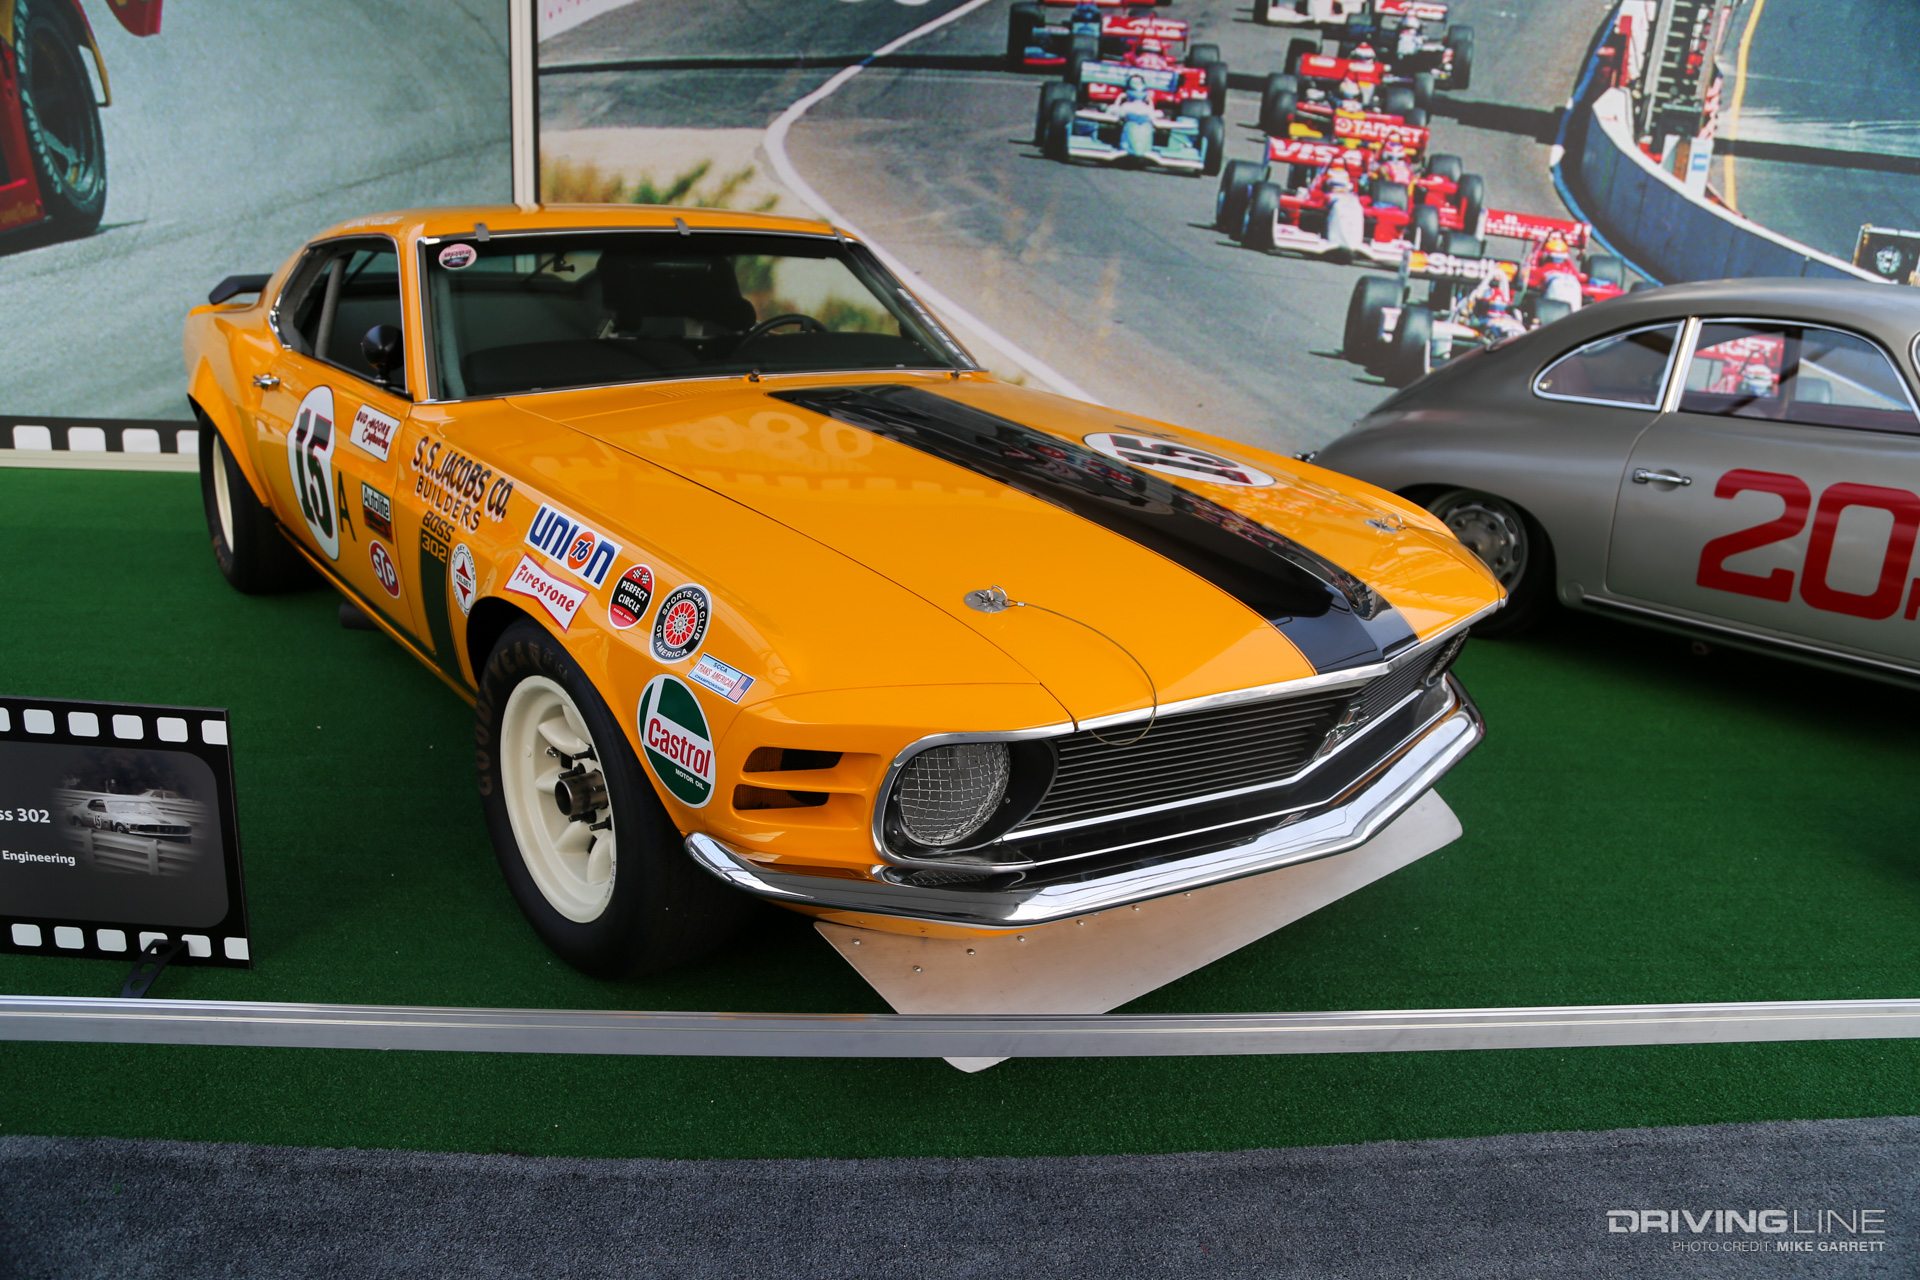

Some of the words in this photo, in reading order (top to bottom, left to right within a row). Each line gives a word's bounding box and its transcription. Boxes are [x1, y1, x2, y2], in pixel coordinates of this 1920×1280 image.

[1269, 138, 1363, 167] VISA
[1109, 434, 1254, 485] 15
[296, 408, 333, 539] 15
[338, 470, 358, 543] A
[363, 486, 390, 520] Autolite
[415, 475, 481, 534] BUILDERS
[484, 477, 514, 523] CO.
[422, 510, 455, 543] BOSS
[421, 533, 447, 563] 302
[570, 539, 594, 562] 76
[1696, 468, 1920, 621] 20
[373, 547, 396, 588] STP
[455, 573, 472, 588] KELSEY
[515, 564, 576, 612] Firestone
[621, 580, 648, 602] PERFECT
[692, 590, 706, 610] CAR
[618, 594, 641, 613] CIRCLE
[662, 590, 693, 616] SPORTS
[656, 624, 663, 639] OF
[693, 611, 706, 641] CLUB
[655, 641, 688, 658] AMERICA
[696, 663, 713, 677] TRANS
[711, 671, 735, 688] AMERICAN
[713, 662, 728, 674] SCCA
[694, 674, 725, 692] CHAMPIONSHIP
[648, 717, 711, 778] Castrol
[675, 768, 694, 784] MOTOR
[694, 779, 705, 791] OIL
[17, 807, 51, 824] 302
[2, 850, 76, 867] Engineering
